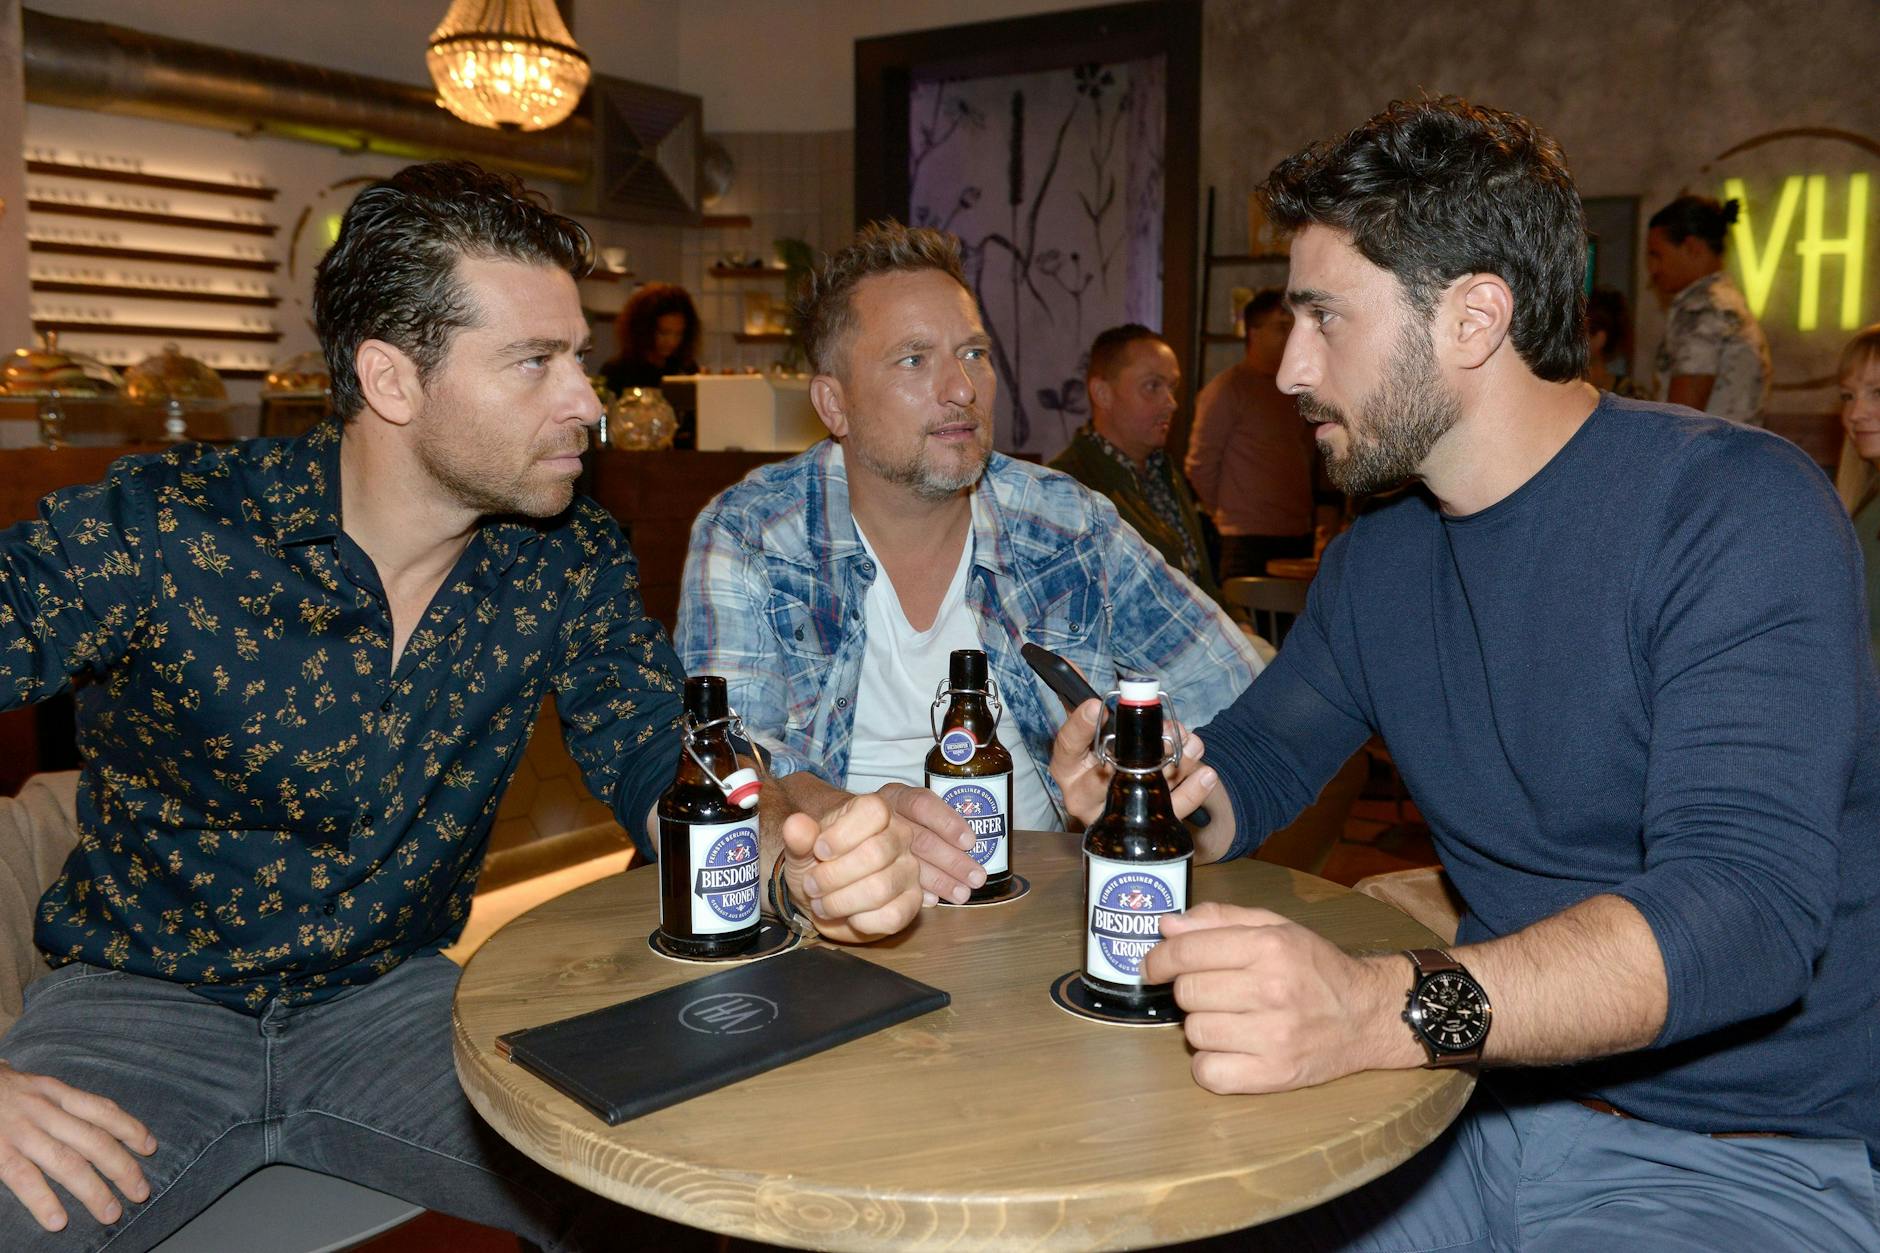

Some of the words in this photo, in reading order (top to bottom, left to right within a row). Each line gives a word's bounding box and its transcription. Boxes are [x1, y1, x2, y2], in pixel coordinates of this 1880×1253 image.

[1724, 172, 1870, 332] VH
[954, 787, 981, 796] BERLINER
[967, 817, 1002, 835] ORFER
[708, 840, 726, 864] FEINSTE
[725, 830, 751, 843] BERLINER
[722, 887, 755, 908] KRONEN
[1102, 882, 1119, 904] FEINSTE
[1119, 875, 1153, 885] BERLINER
[1095, 908, 1163, 935] BIESDORF
